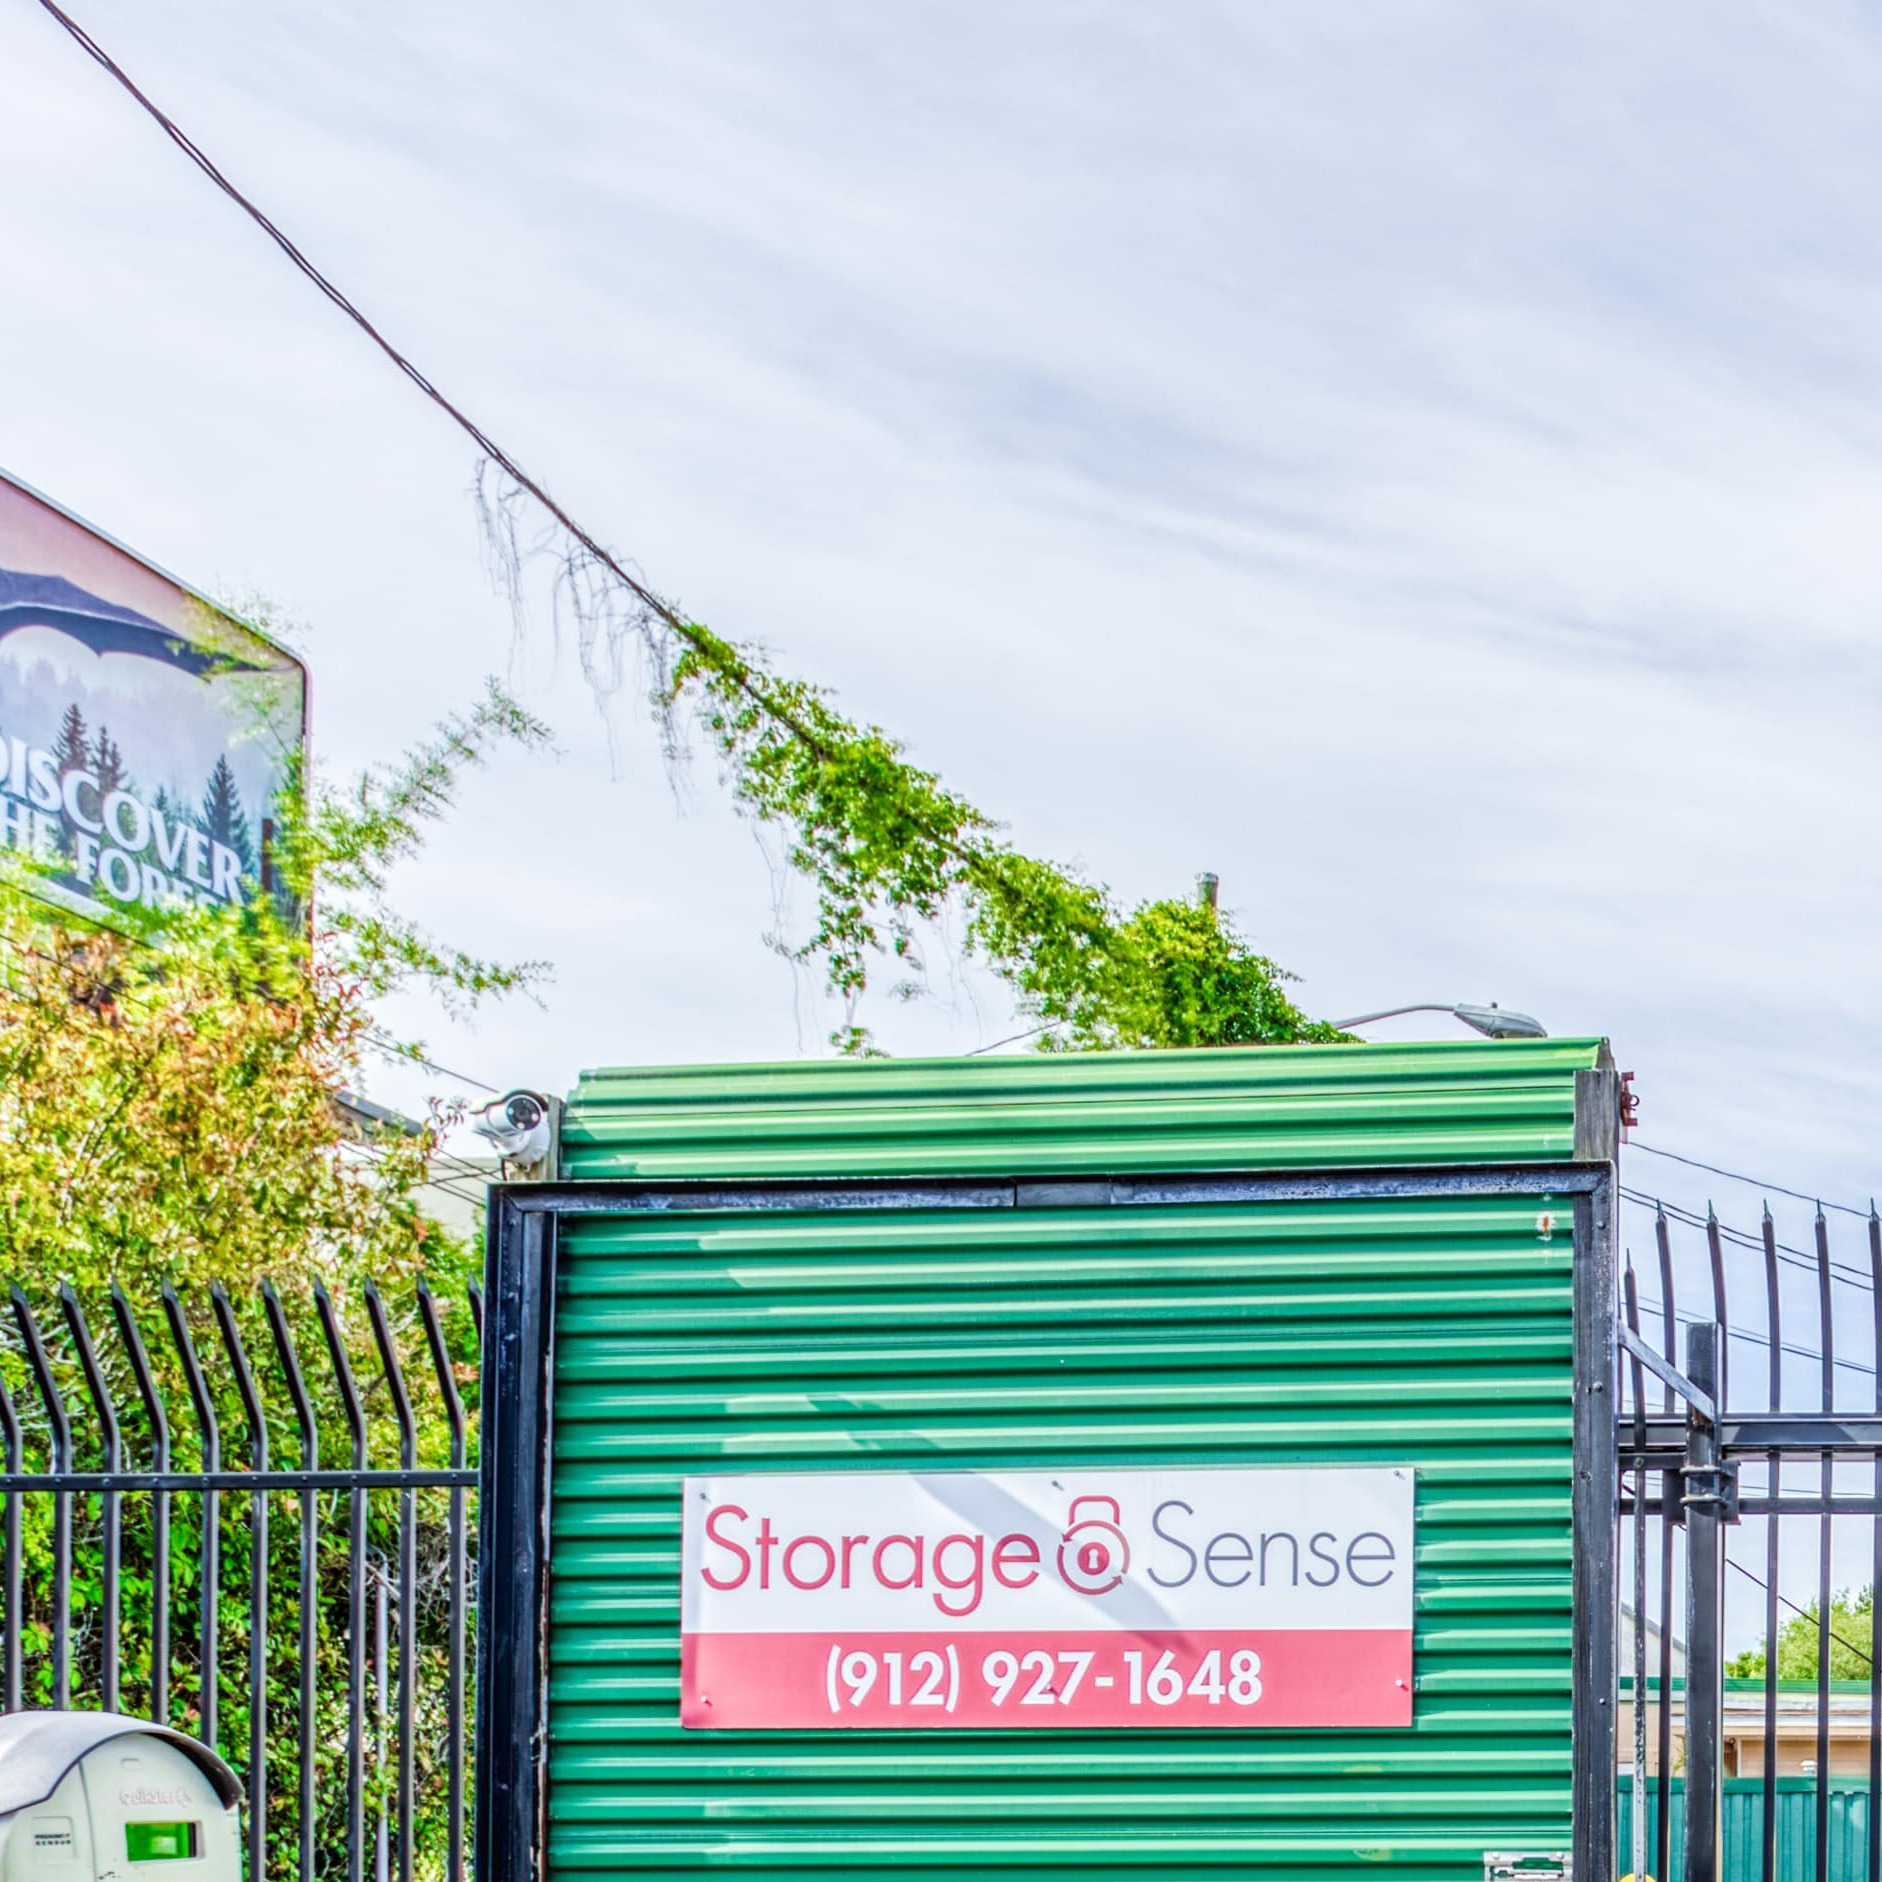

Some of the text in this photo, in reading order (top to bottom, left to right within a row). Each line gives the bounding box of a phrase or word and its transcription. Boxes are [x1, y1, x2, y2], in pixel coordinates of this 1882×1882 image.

[0, 736, 245, 906] ISCOVER
[0, 798, 58, 866] HE
[700, 1500, 1397, 1617] Storage Sense
[826, 1645, 1263, 1713] (912) 927-1648
